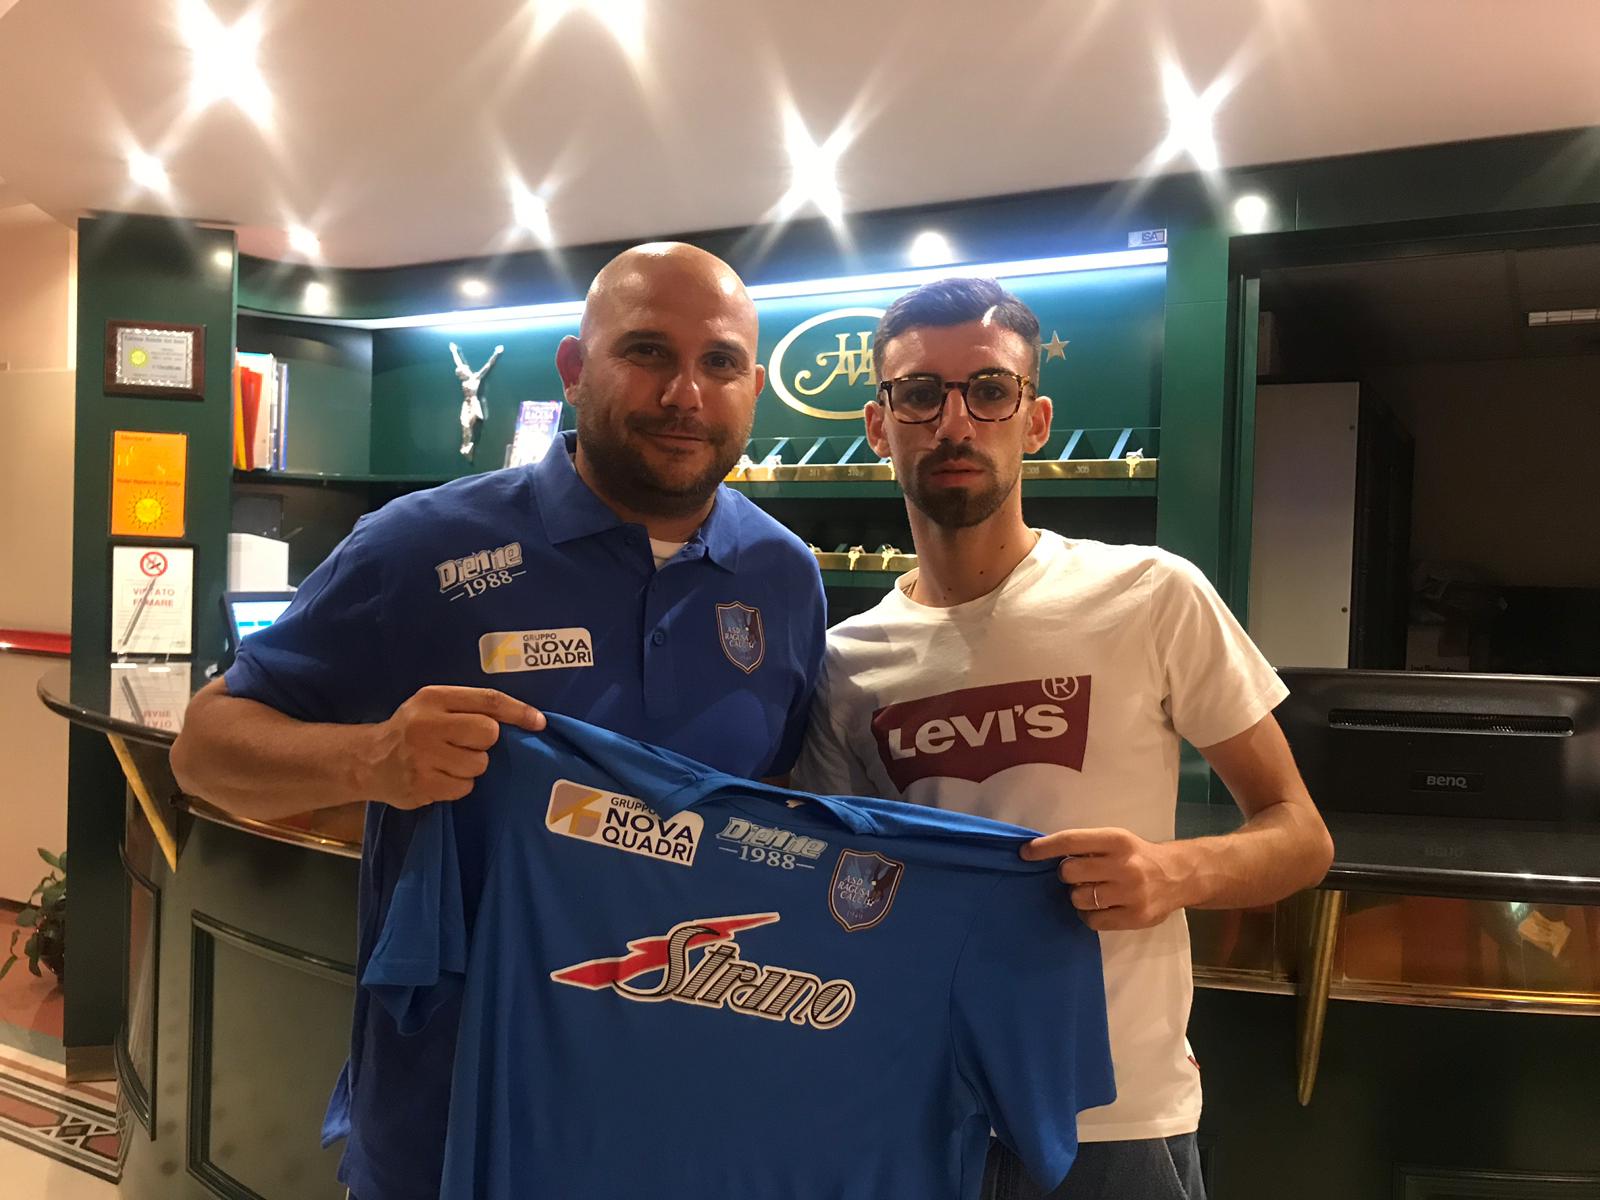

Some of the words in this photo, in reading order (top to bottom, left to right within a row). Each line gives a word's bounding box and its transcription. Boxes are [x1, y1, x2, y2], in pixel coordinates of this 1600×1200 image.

[435, 542, 523, 593] Dienne
[133, 587, 175, 597] VIATO
[463, 570, 513, 598] 1988
[133, 599, 173, 608] FMARE
[522, 632, 557, 642] GRUPPO
[523, 638, 590, 655] NOVA
[524, 651, 592, 667] QUADRI
[1426, 775, 1468, 789] BenQ
[605, 807, 694, 844] NOVA
[601, 825, 694, 863] QUADRI
[716, 817, 829, 860] Dienne
[738, 845, 796, 870] 1988
